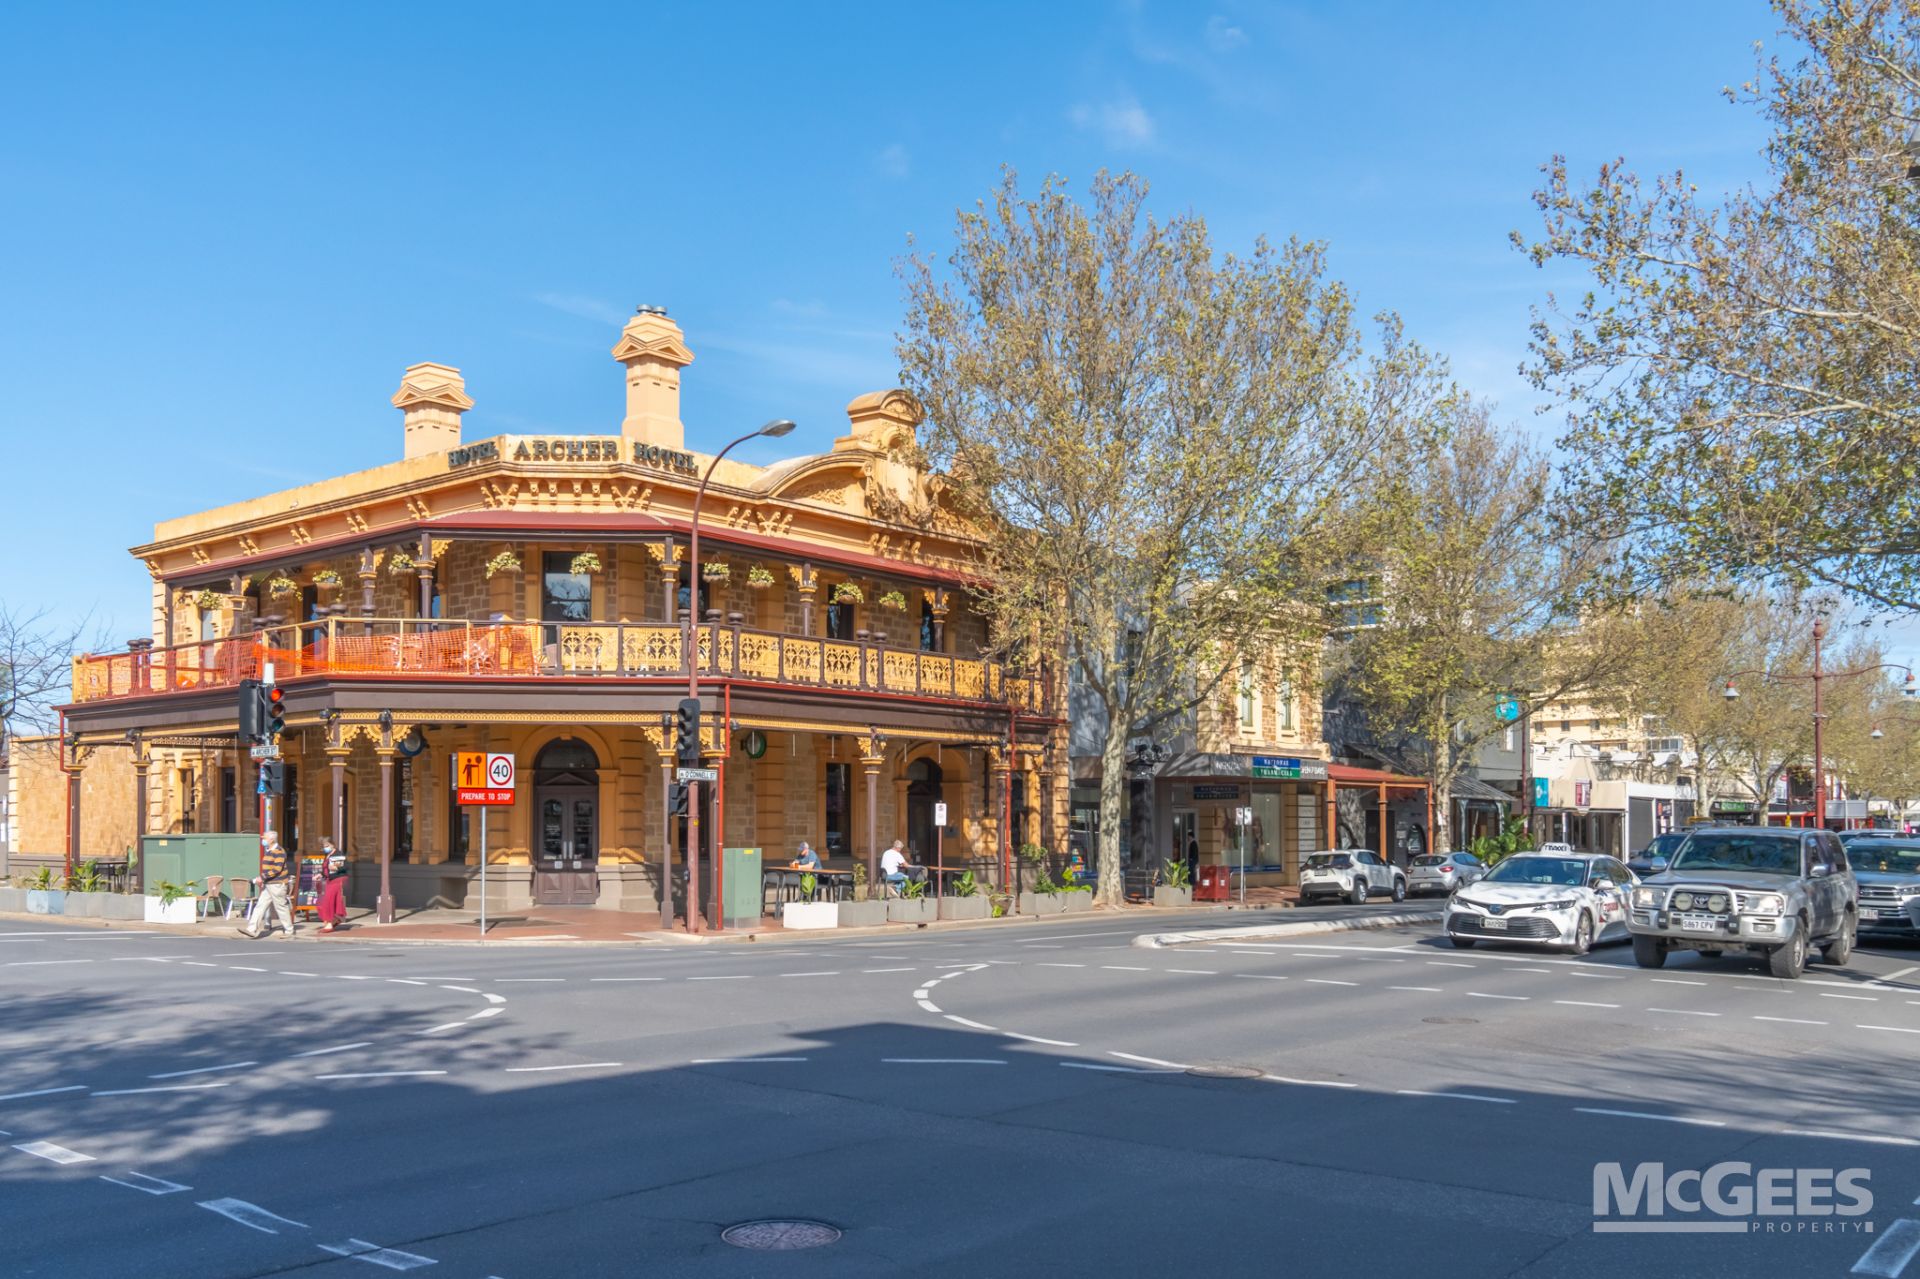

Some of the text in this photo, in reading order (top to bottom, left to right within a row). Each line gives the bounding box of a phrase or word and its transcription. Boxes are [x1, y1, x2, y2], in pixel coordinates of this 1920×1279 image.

[448, 441, 499, 467] HOTEL
[514, 440, 618, 459] ARCHER
[634, 442, 697, 472] HOTEL
[493, 765, 509, 777] 40
[461, 792, 511, 801] PREPARE TO STOP
